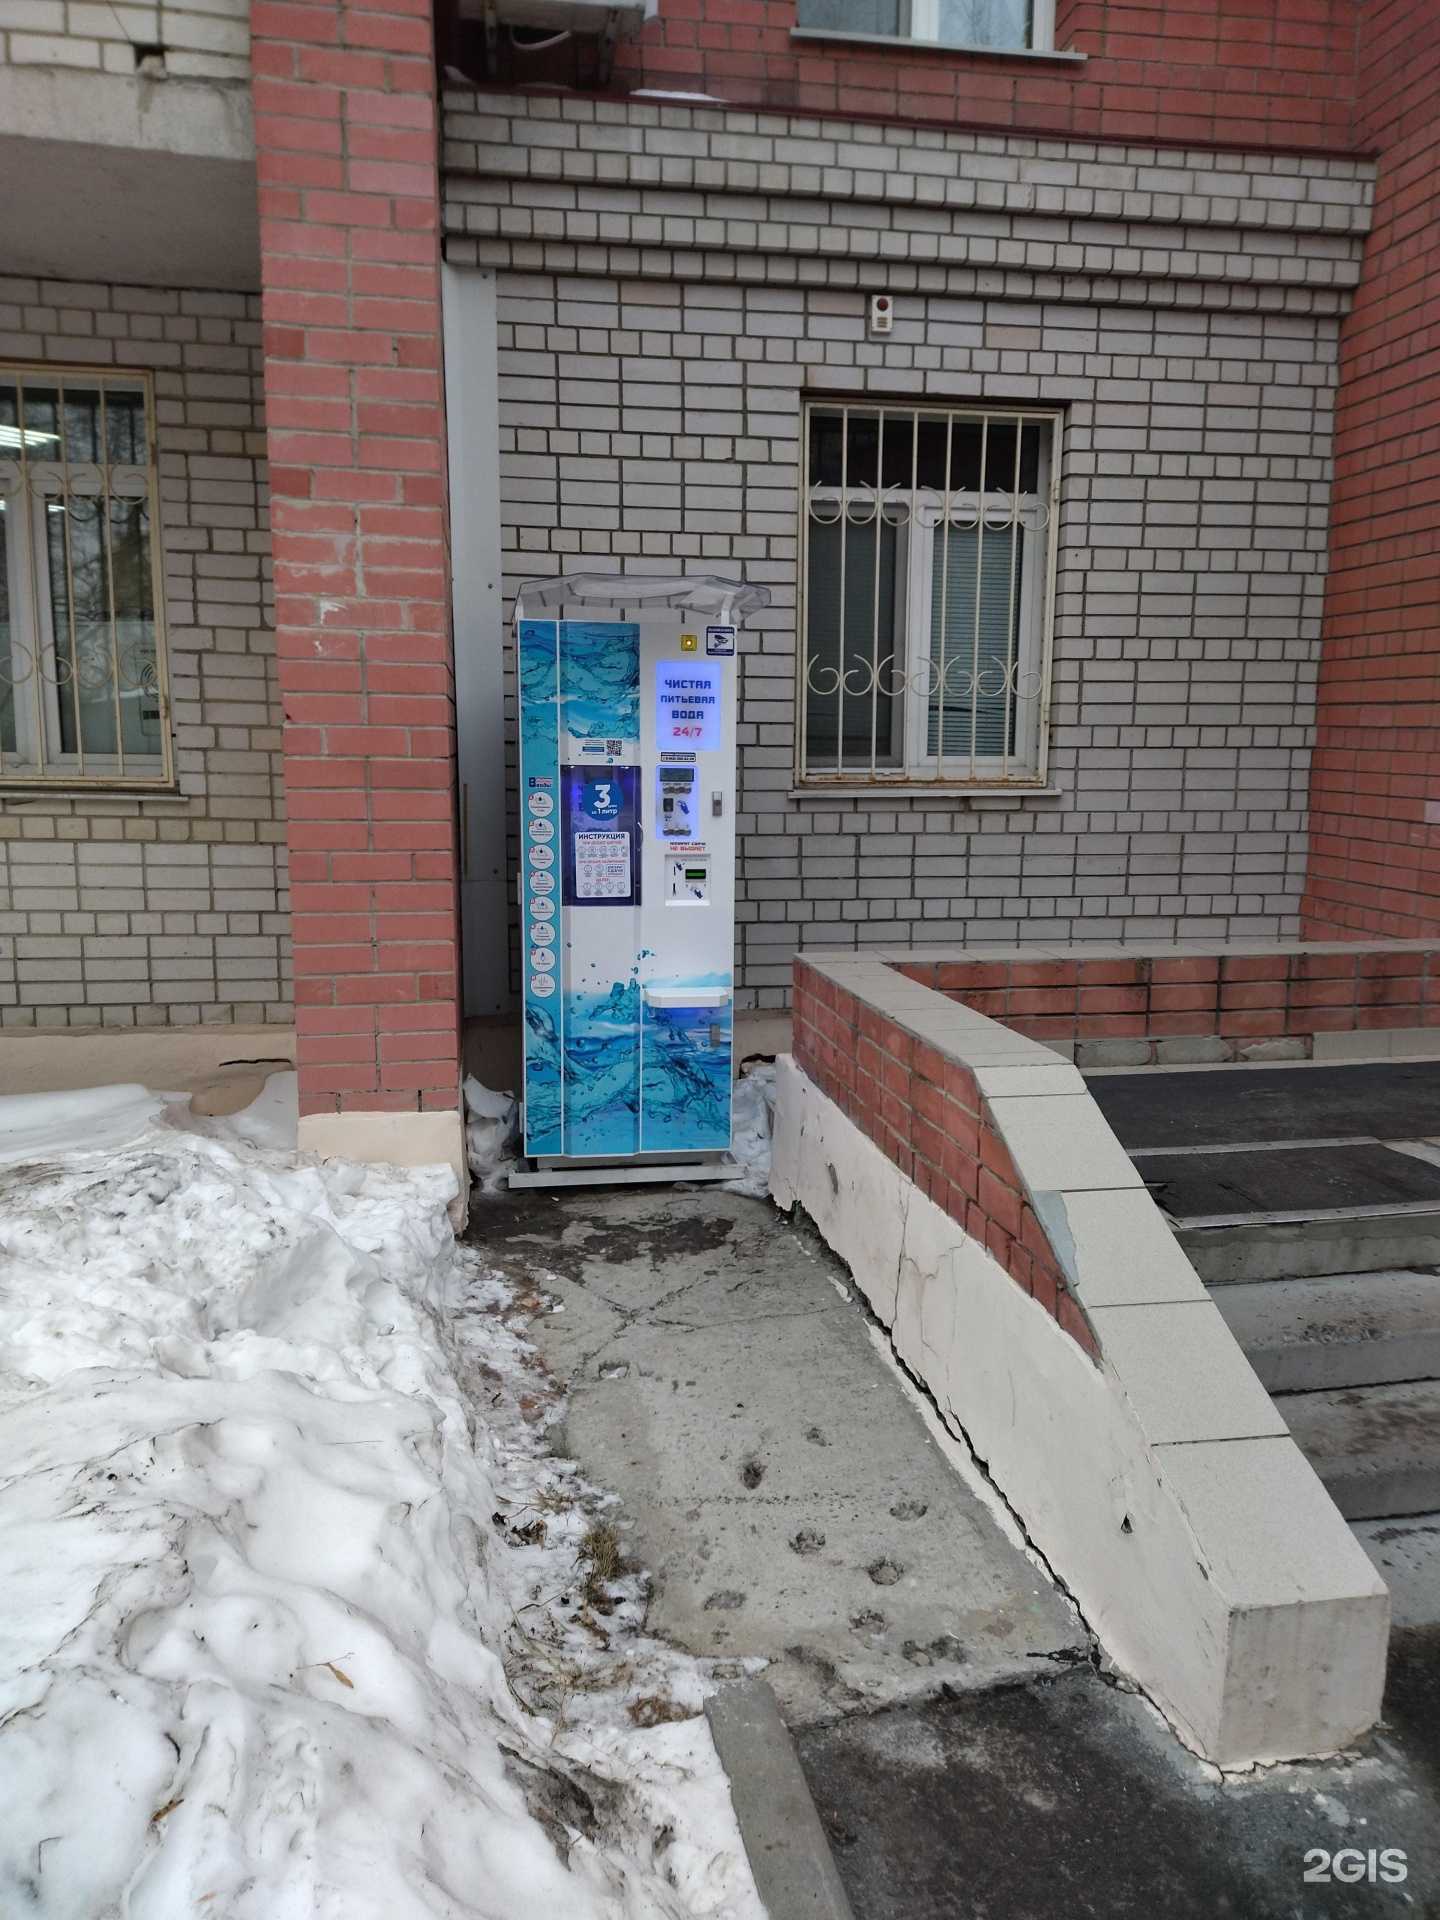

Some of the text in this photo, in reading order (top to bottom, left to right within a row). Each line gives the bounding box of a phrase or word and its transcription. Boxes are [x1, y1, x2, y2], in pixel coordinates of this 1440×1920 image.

[664, 679, 712, 689] ЧИСТАЯ
[660, 695, 716, 704] ПИТЬЕВАЯ
[671, 710, 705, 719] ВОДА
[672, 727, 703, 737] 24/7
[593, 784, 611, 808] 3
